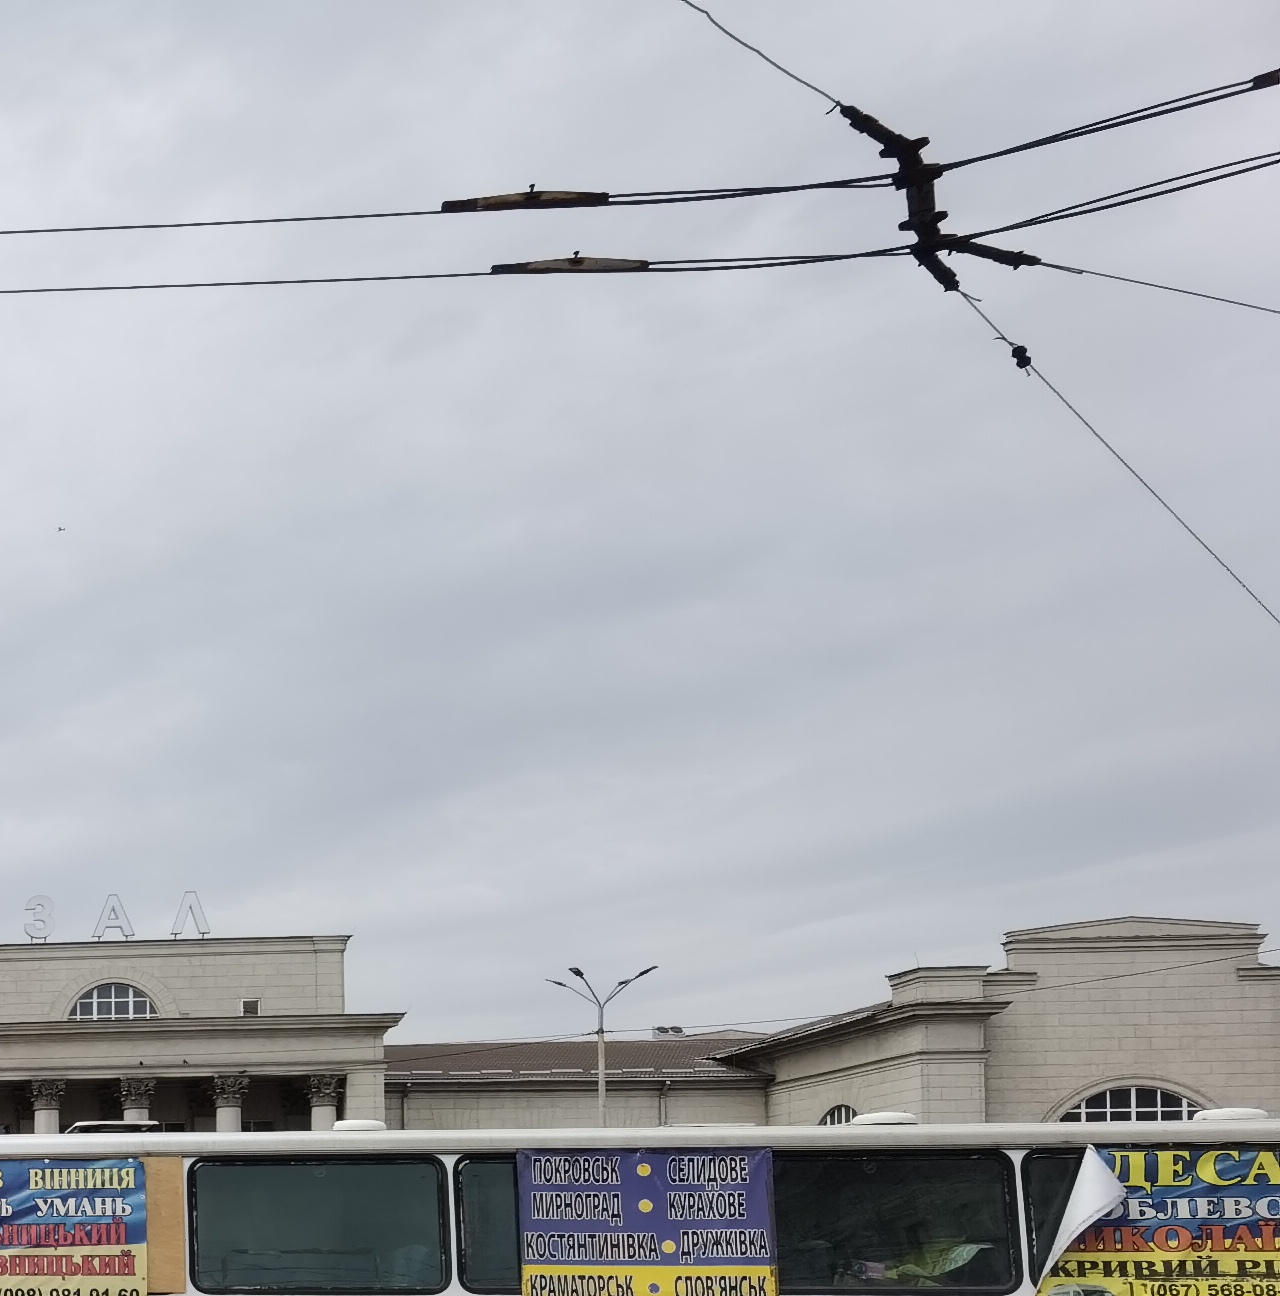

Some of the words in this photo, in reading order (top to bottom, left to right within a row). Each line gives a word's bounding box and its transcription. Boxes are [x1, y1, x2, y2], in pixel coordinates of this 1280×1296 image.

[28, 1167, 136, 1193] ВІННИЦЯ
[531, 1156, 621, 1185] ПОКРОВСЬК
[666, 1156, 749, 1191] СЕЛИДОВЕ
[34, 1196, 132, 1217] УМАНЬ
[531, 1192, 623, 1226] МИРНОГРАД
[667, 1191, 747, 1220] КУРАХОВЕ
[524, 1232, 661, 1260] КОСТЯНТИНІВКА
[679, 1229, 770, 1264] ДРУЖКІВКА
[1050, 1255, 1220, 1279] КРИВИЙ
